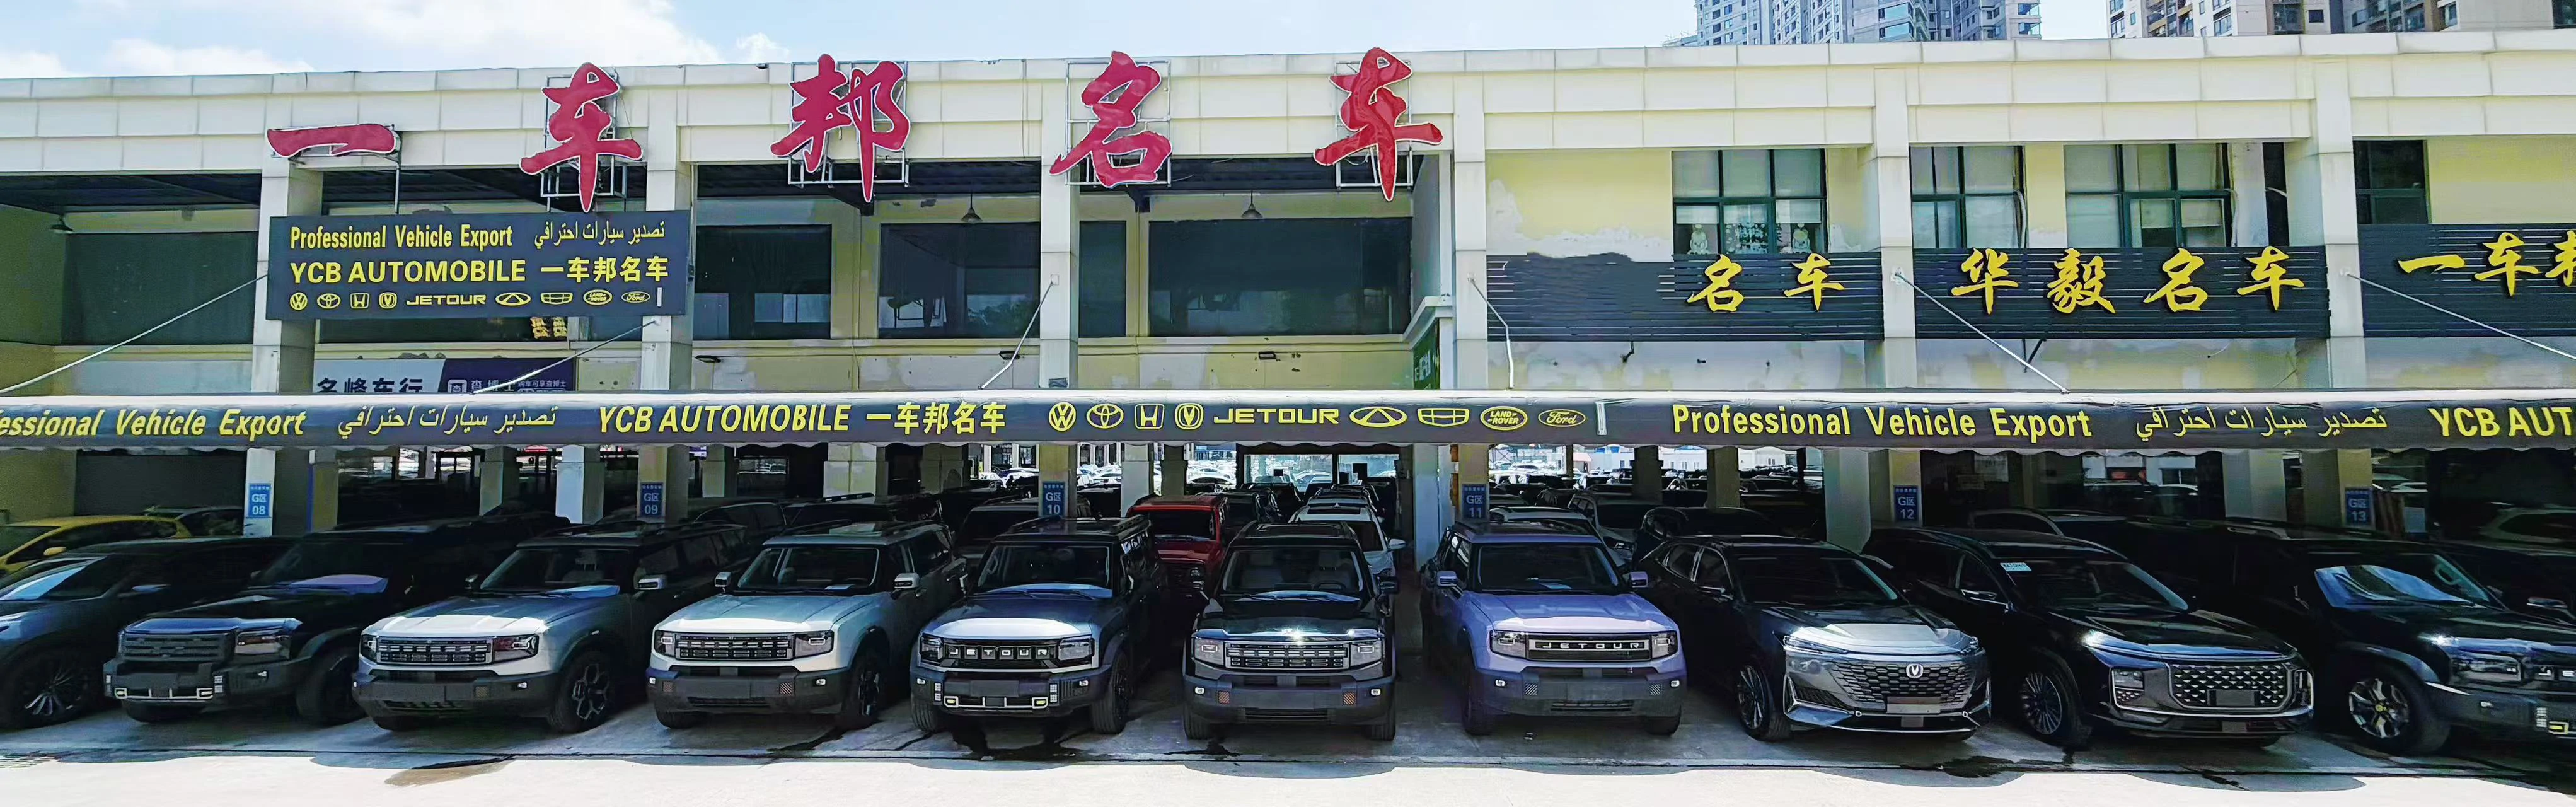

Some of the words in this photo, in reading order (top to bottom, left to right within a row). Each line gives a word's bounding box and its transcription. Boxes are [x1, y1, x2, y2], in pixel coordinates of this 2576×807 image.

[267, 47, 1443, 213] 一车邦名车
[290, 226, 386, 249] Professional
[395, 225, 453, 248] Vehicle
[460, 224, 513, 252] Export
[534, 221, 578, 249] احترافي
[583, 221, 624, 245] سيارات
[628, 221, 665, 245] تصدير
[291, 262, 341, 284] YCB
[348, 260, 526, 283] AUTOMOBILE
[540, 255, 669, 282] 一车邦名车
[1688, 253, 1845, 313] 名车
[407, 294, 487, 306] JETOUR
[0, 409, 106, 436] essional
[115, 409, 206, 436] Vehicle
[218, 409, 306, 441] Export
[338, 405, 415, 439] احترافي
[420, 404, 488, 434] سيارات
[494, 406, 558, 434] تصدير
[599, 405, 652, 433] YCB
[659, 404, 851, 433] AUTOMOBILE
[866, 402, 1007, 435] 一车邦名车
[1213, 408, 1339, 425] JETOUR
[1546, 411, 1578, 424] Ford
[1672, 404, 1851, 436] Professional
[1866, 407, 1977, 436] Vehicle
[1989, 407, 2093, 443] Export
[2135, 406, 2216, 441] احترافي
[2225, 406, 2307, 438] سيارات
[2318, 407, 2388, 438] تصدير
[2427, 407, 2501, 437] YCB
[2508, 407, 2573, 436] AUT
[252, 505, 266, 515] 08
[645, 504, 658, 514] 09
[1047, 504, 1060, 514] 10
[1469, 507, 1482, 518] 11
[1900, 508, 1915, 519] 12
[2352, 511, 2367, 521] 13
